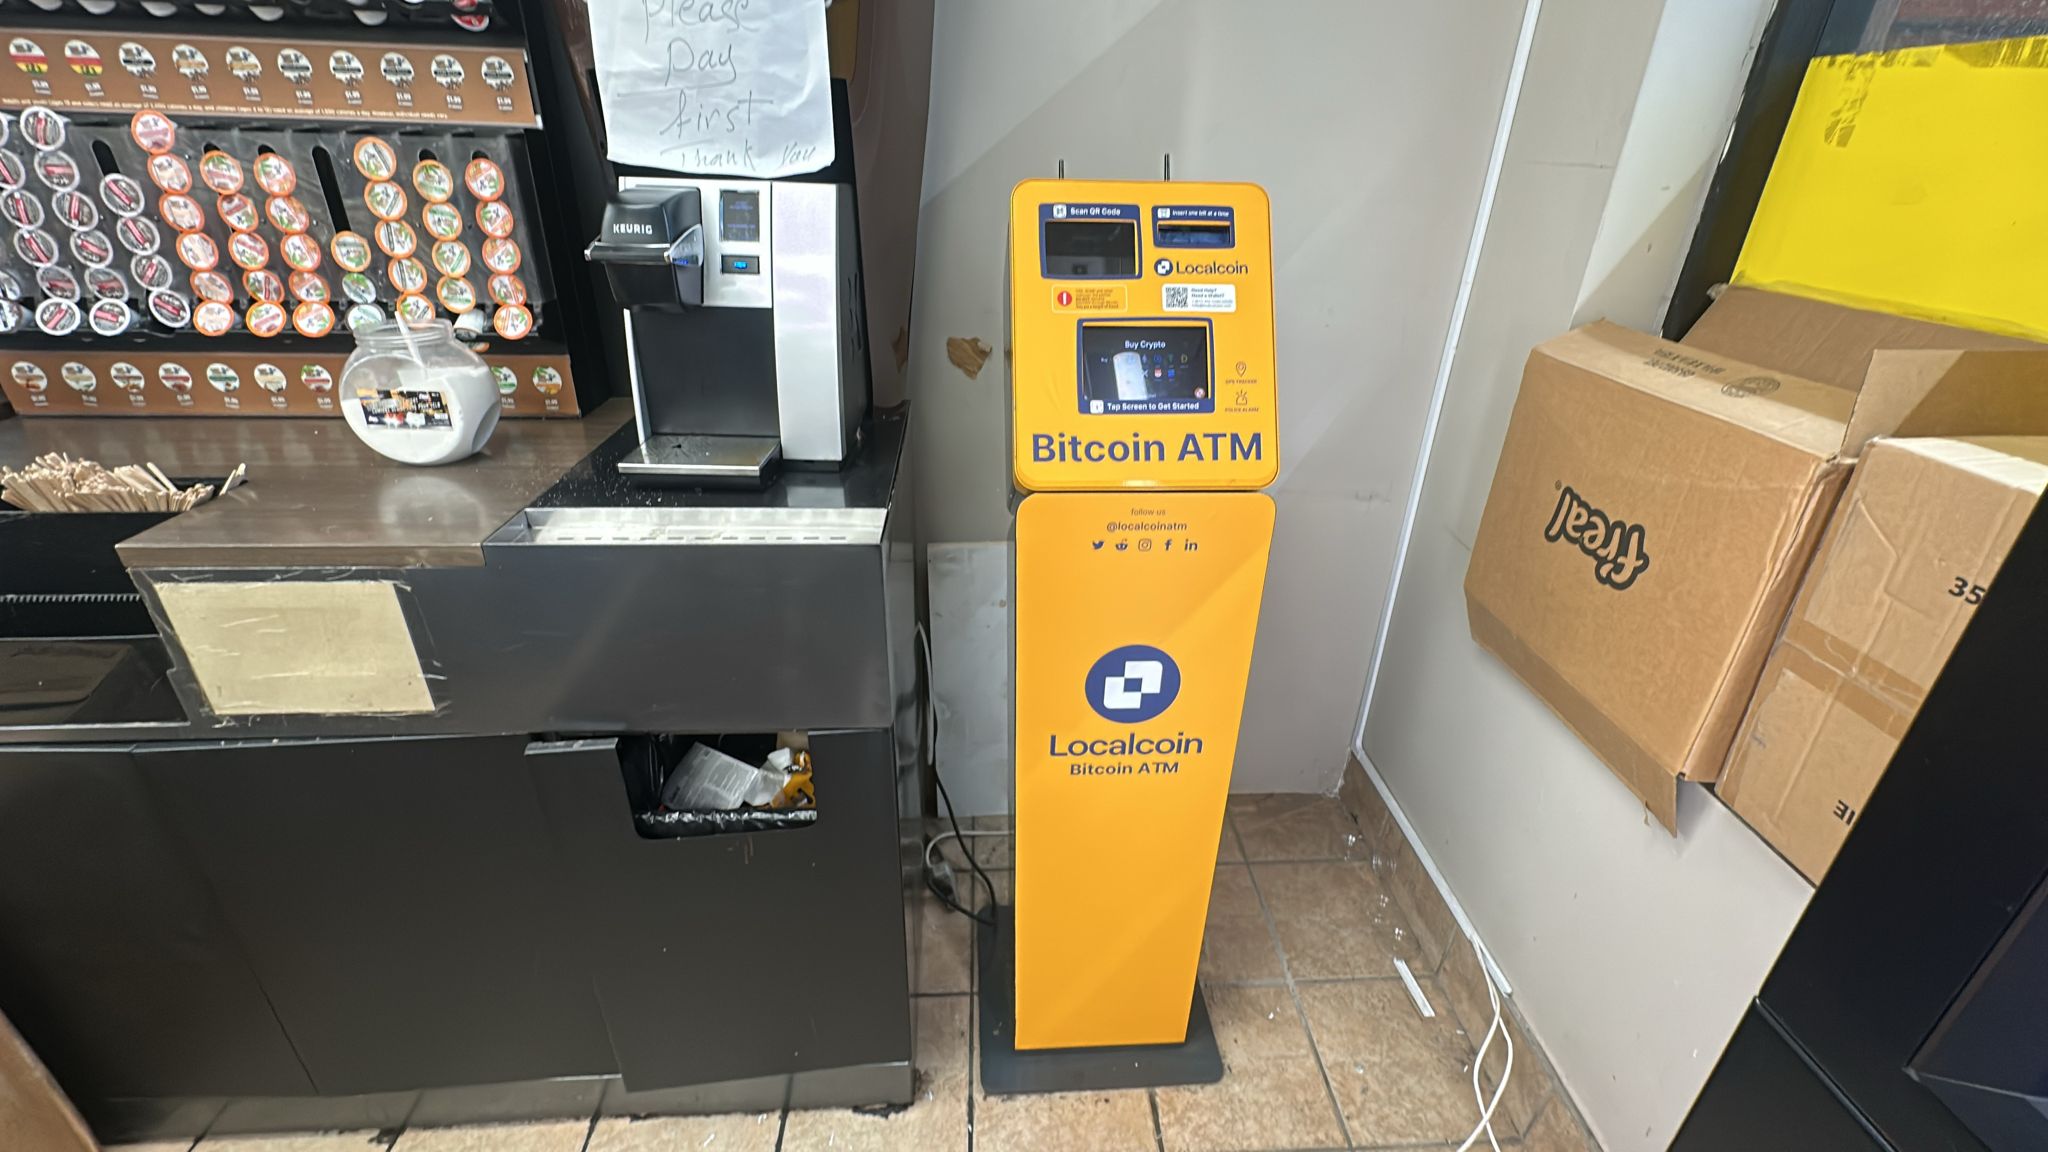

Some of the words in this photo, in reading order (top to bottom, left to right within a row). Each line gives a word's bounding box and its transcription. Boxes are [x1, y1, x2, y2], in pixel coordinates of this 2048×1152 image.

[1070, 207, 1088, 216] Scan
[1090, 207, 1100, 216] QR
[1102, 207, 1121, 216] Code
[613, 223, 653, 235] KEURIG
[1176, 260, 1249, 275] Localcoin
[1124, 340, 1139, 349] Buy
[1140, 340, 1166, 350] Crypto
[1107, 403, 1120, 411] Tap
[1172, 402, 1200, 410] Started
[1032, 432, 1165, 463] Bitcoin
[1177, 433, 1262, 461] ATM
[1131, 508, 1154, 516] follow
[1106, 521, 1187, 532] @localcoinatm
[1050, 732, 1203, 757] Localcoin
[1070, 762, 1133, 776] Bitcoin
[1138, 762, 1179, 774] ATM
